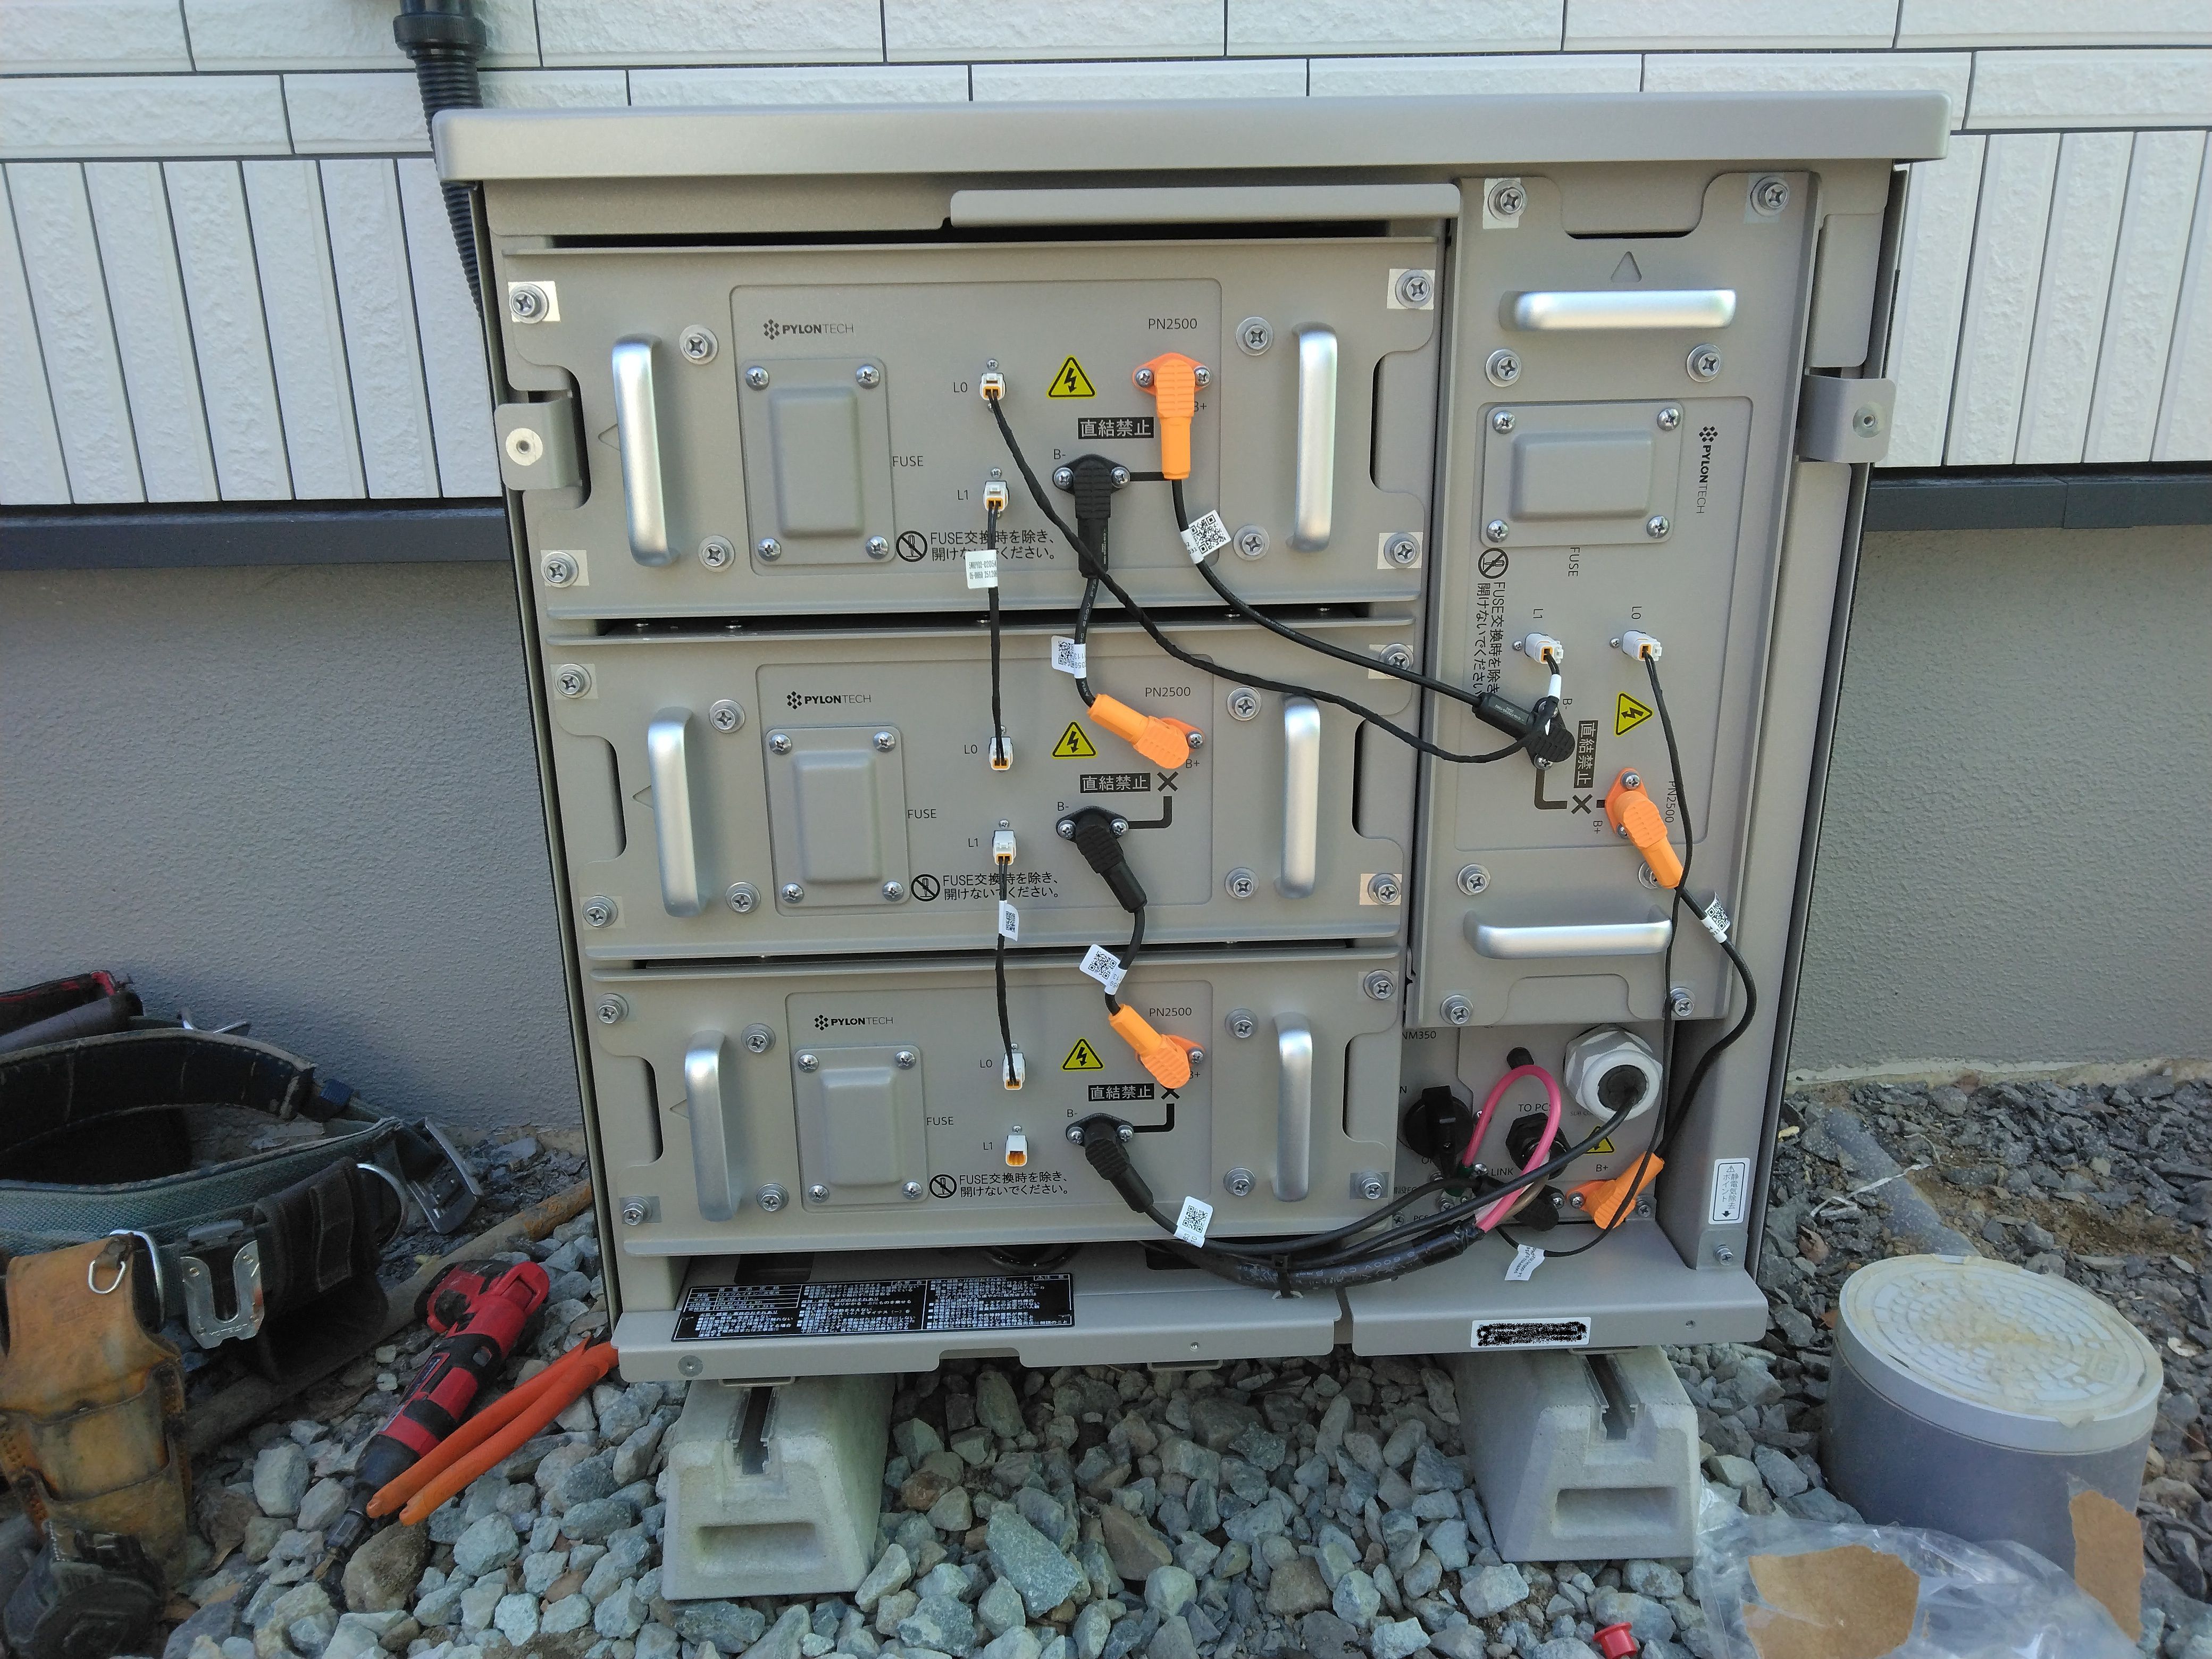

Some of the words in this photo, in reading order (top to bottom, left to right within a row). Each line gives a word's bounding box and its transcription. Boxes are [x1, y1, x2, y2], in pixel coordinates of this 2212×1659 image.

[783, 324, 853, 334] PYLONTECH
[1148, 318, 1197, 330] PN2500
[1080, 420, 1151, 436] 直結禁止
[1053, 449, 1066, 460] B-
[892, 456, 924, 467] FUSE
[1696, 445, 1712, 514] PYLONTECH
[957, 490, 968, 500] L1
[1568, 547, 1580, 577] FUSE
[1145, 686, 1191, 698] PN2500
[805, 695, 871, 705] PYLONTECH
[1562, 698, 1573, 710] B-
[1576, 723, 1595, 786] 直結禁止
[1185, 758, 1201, 769] B+
[1083, 775, 1148, 790] 直結禁止
[1057, 801, 1069, 811] B-
[1664, 781, 1677, 823] PN2500
[907, 808, 937, 819] FUSE
[1594, 821, 1603, 834] B+
[968, 837, 978, 848] L1
[1149, 1007, 1192, 1017] PN2500
[831, 1017, 893, 1026] PYLONTECH
[1090, 1085, 1152, 1100] 直結禁止
[1518, 1104, 1532, 1112] TO
[1535, 1103, 1551, 1112] PC
[1067, 1109, 1078, 1118] B-
[927, 1116, 954, 1126] FUSE
[983, 1142, 993, 1151] L1
[1491, 1168, 1514, 1176] LINK
[1596, 1164, 1609, 1172] B+
[959, 1171, 1068, 1185] FUSE交換時を除き、
[960, 1184, 1069, 1197] 開けないでください。
[1722, 1174, 1731, 1202] ポイント
[1728, 1173, 1739, 1209] 静電気除去
